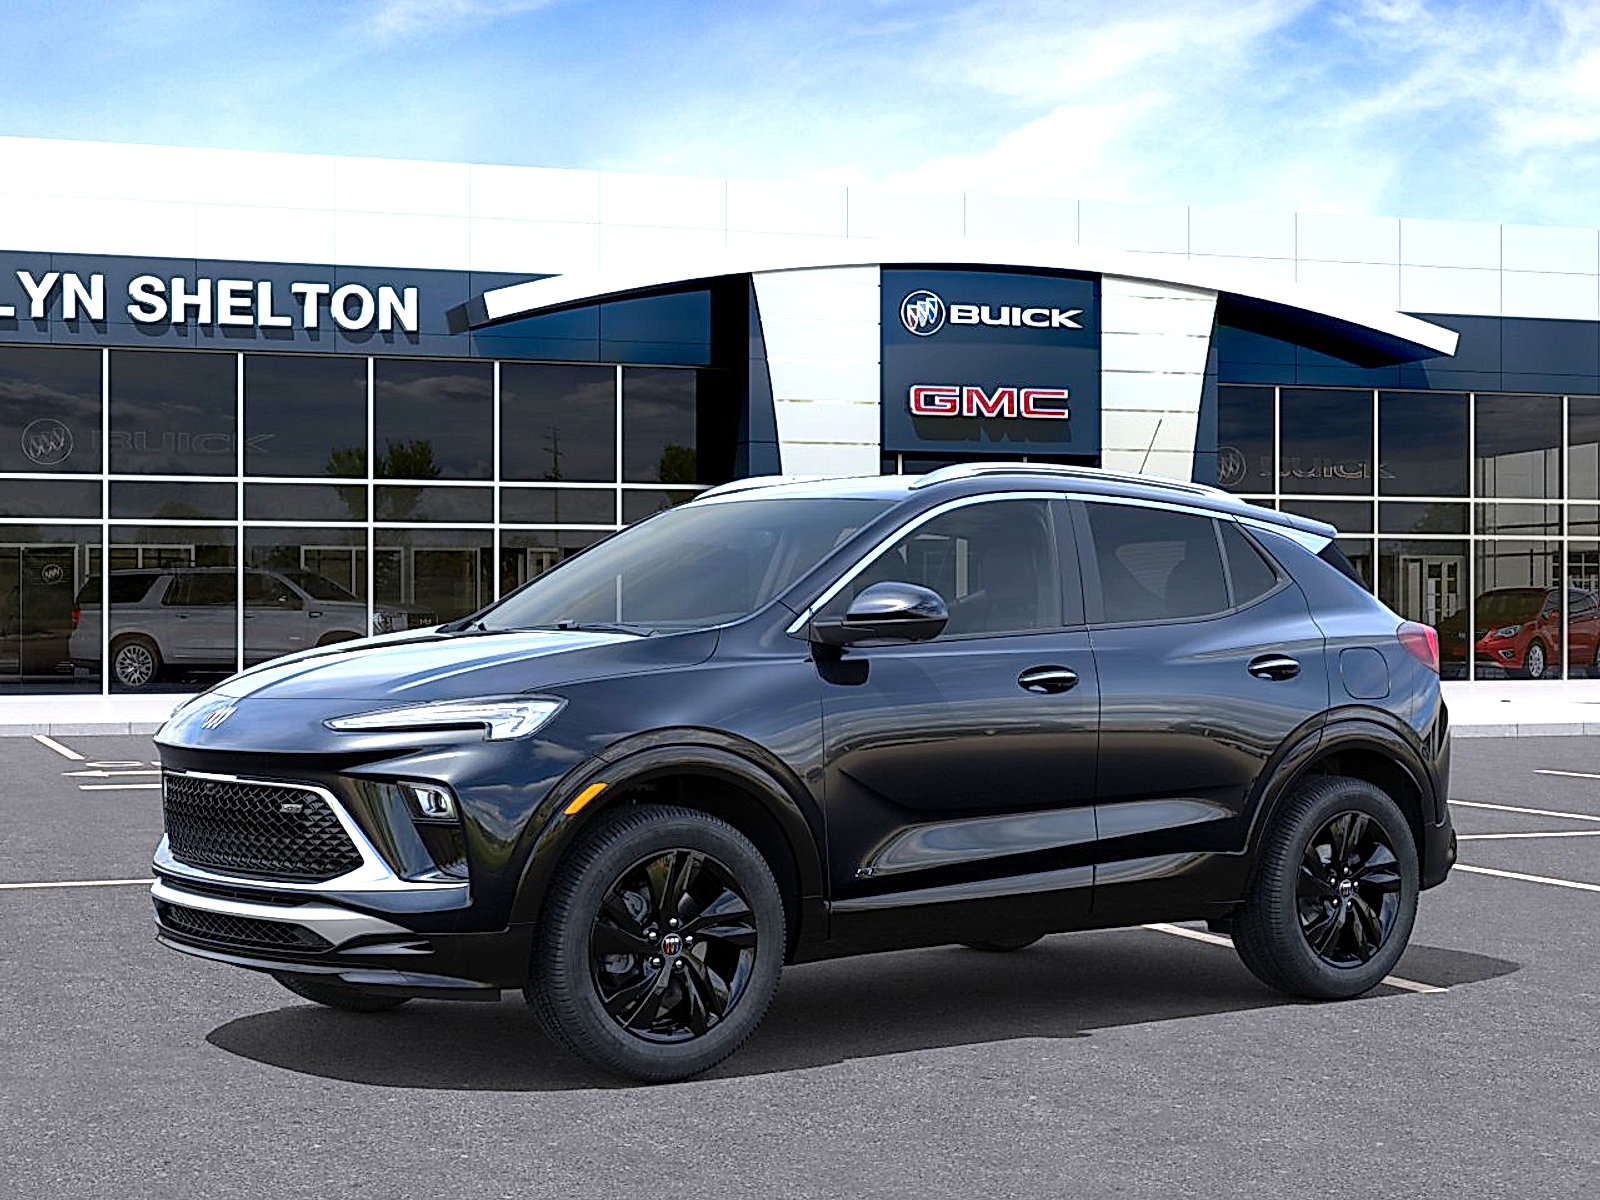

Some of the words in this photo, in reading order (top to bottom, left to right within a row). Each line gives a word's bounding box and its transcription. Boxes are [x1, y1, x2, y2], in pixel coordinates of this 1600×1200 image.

[0, 271, 104, 320] YN
[127, 275, 419, 332] SHELTON
[950, 304, 1083, 329] BUICK
[909, 385, 1069, 419] GMC
